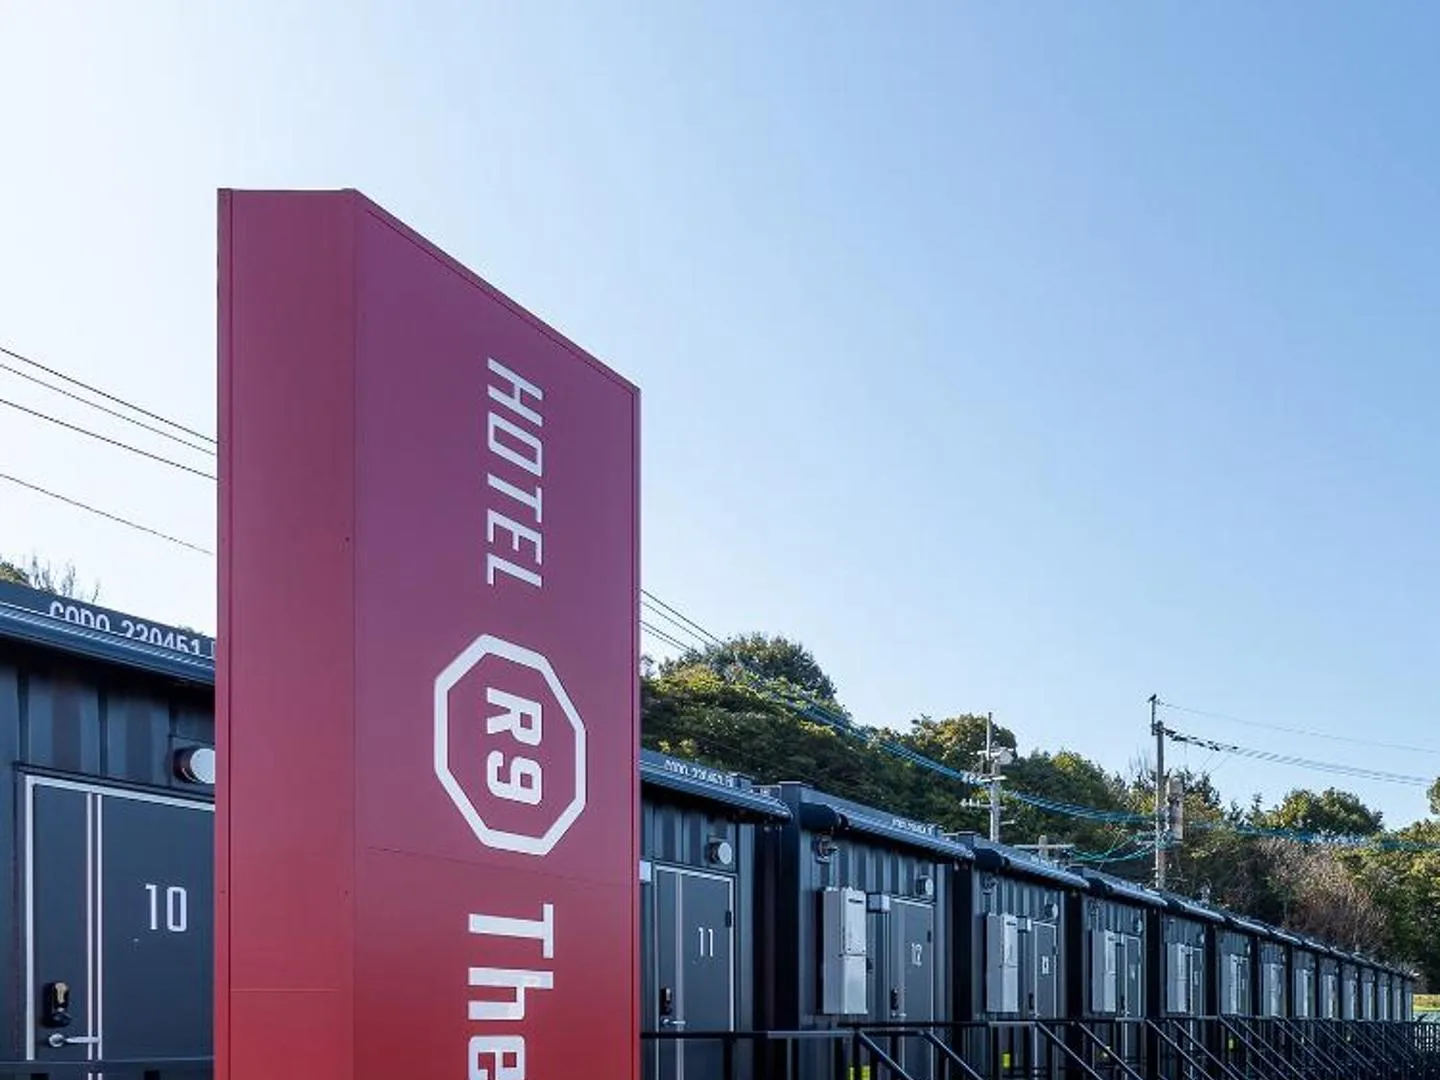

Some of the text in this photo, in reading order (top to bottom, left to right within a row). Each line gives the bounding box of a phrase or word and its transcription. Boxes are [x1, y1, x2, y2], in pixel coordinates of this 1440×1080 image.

[486, 356, 543, 588] HOTEL
[486, 686, 543, 807] R9
[144, 883, 188, 933] 10
[697, 926, 715, 958] 11
